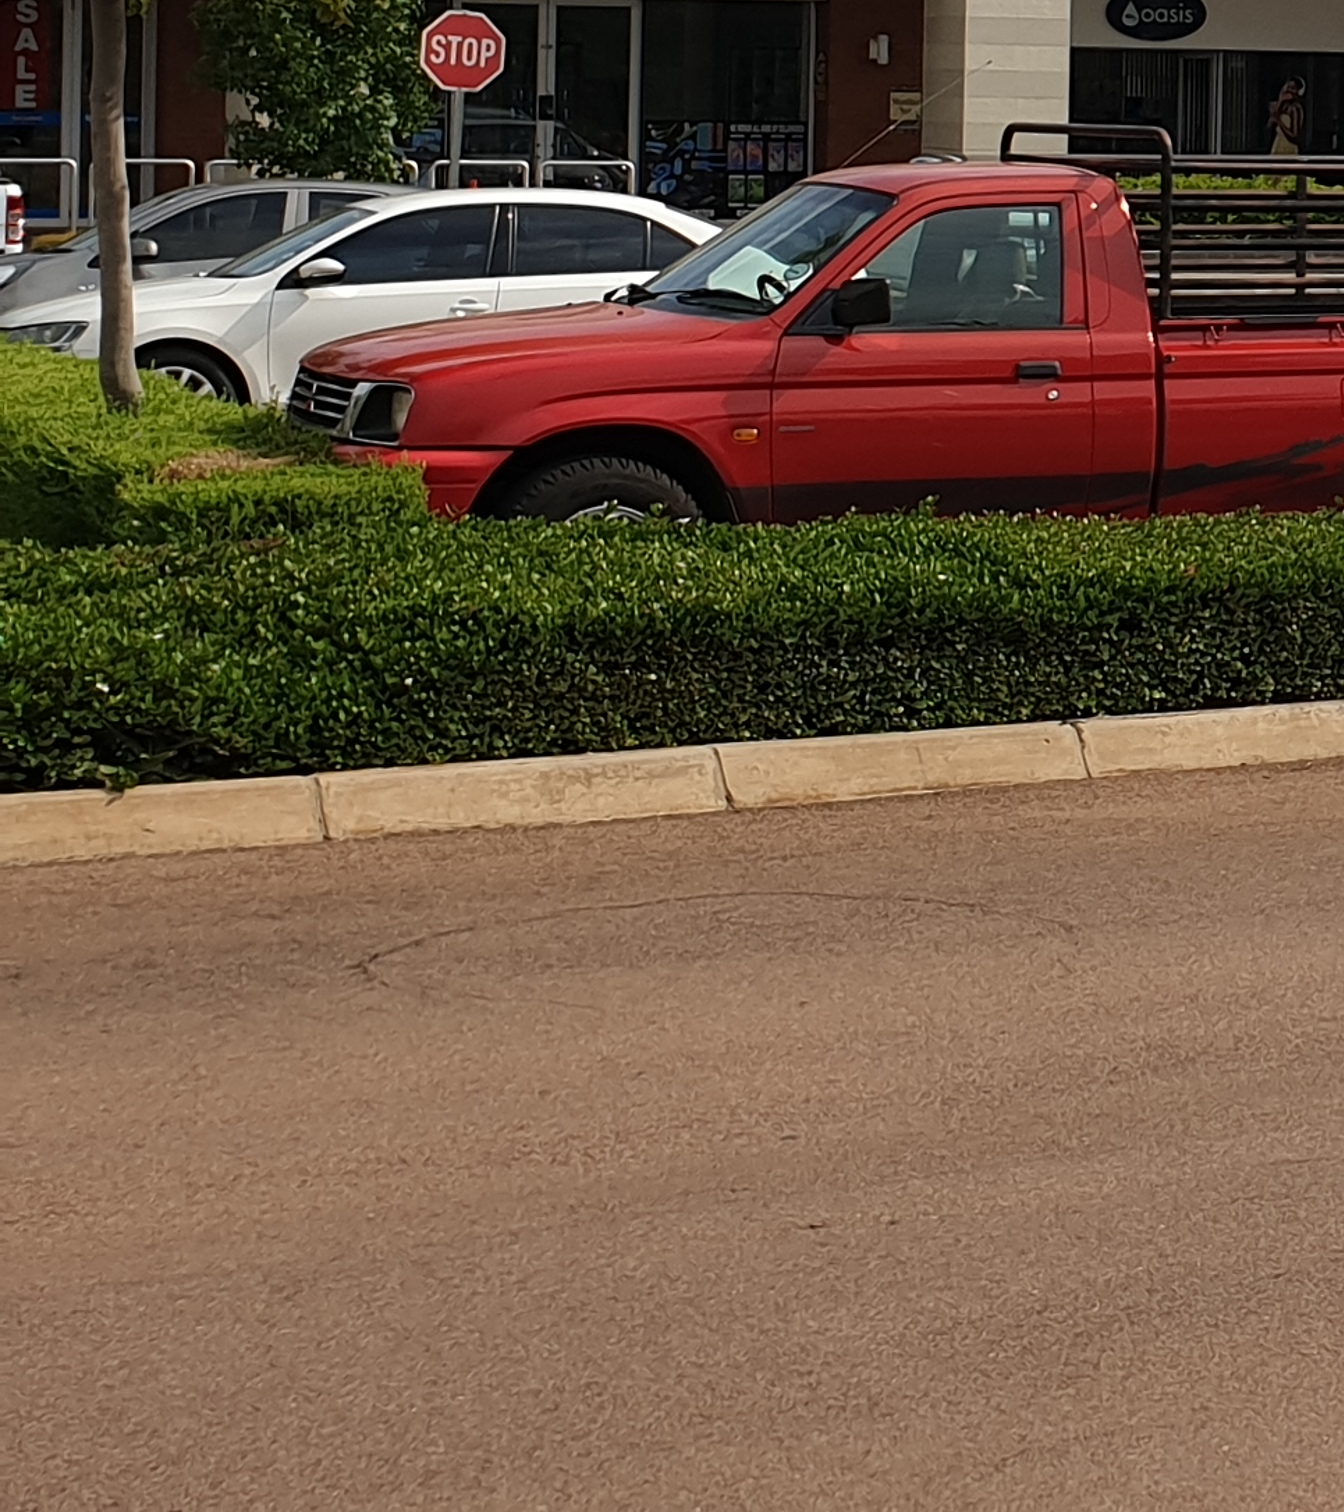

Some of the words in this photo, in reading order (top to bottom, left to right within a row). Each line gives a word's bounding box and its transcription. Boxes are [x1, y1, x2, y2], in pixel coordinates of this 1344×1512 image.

[1141, 2, 1194, 24] oasis
[14, 0, 39, 109] SALE
[429, 34, 497, 68] STOP
